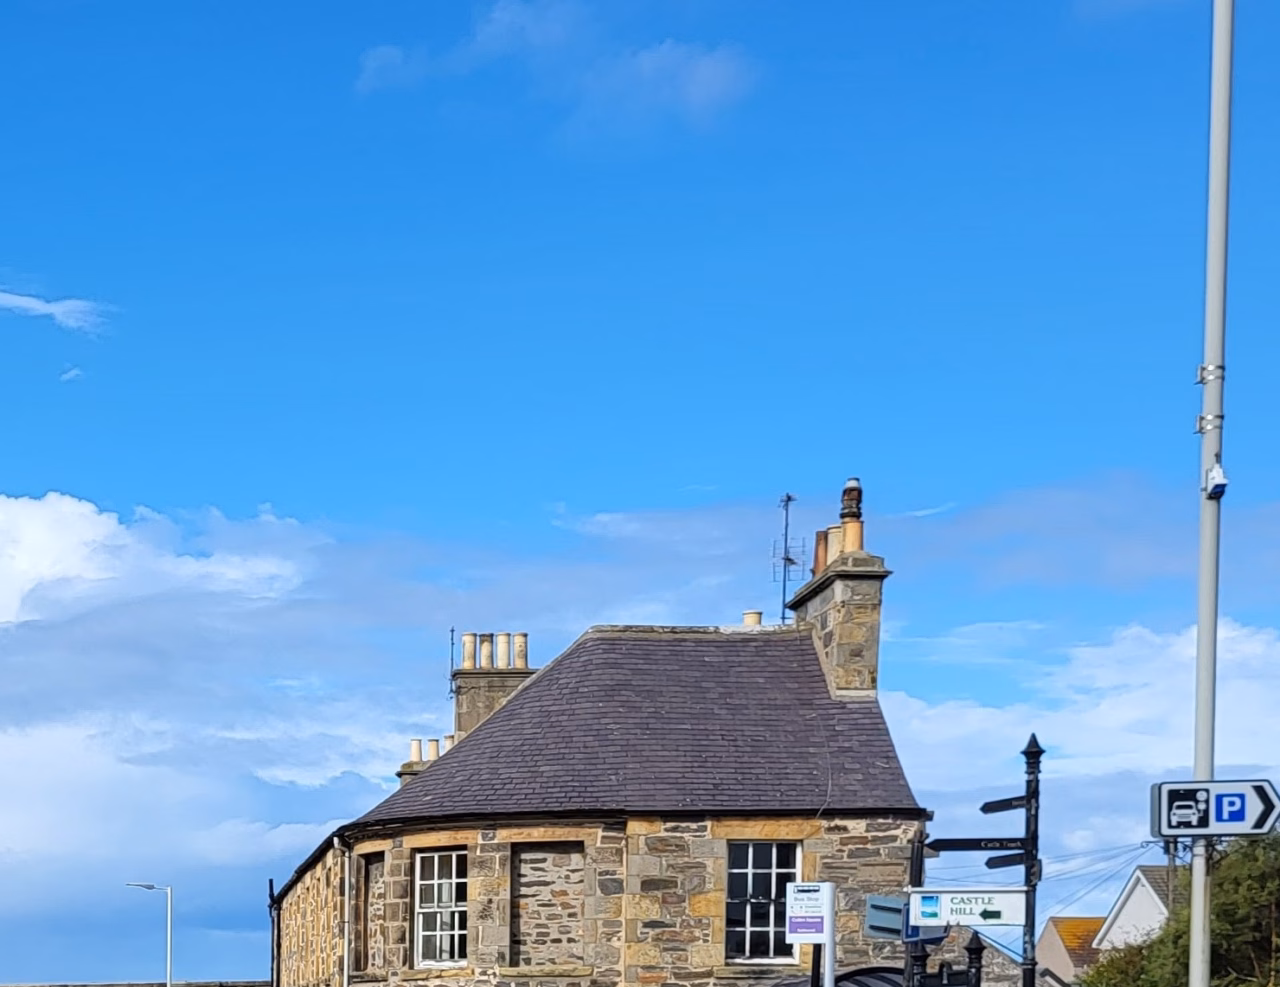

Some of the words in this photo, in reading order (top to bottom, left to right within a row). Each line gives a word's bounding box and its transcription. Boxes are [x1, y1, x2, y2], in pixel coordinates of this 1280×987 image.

[1222, 796, 1241, 820] P
[950, 896, 995, 906] CASTLE
[950, 907, 976, 916] HILL
